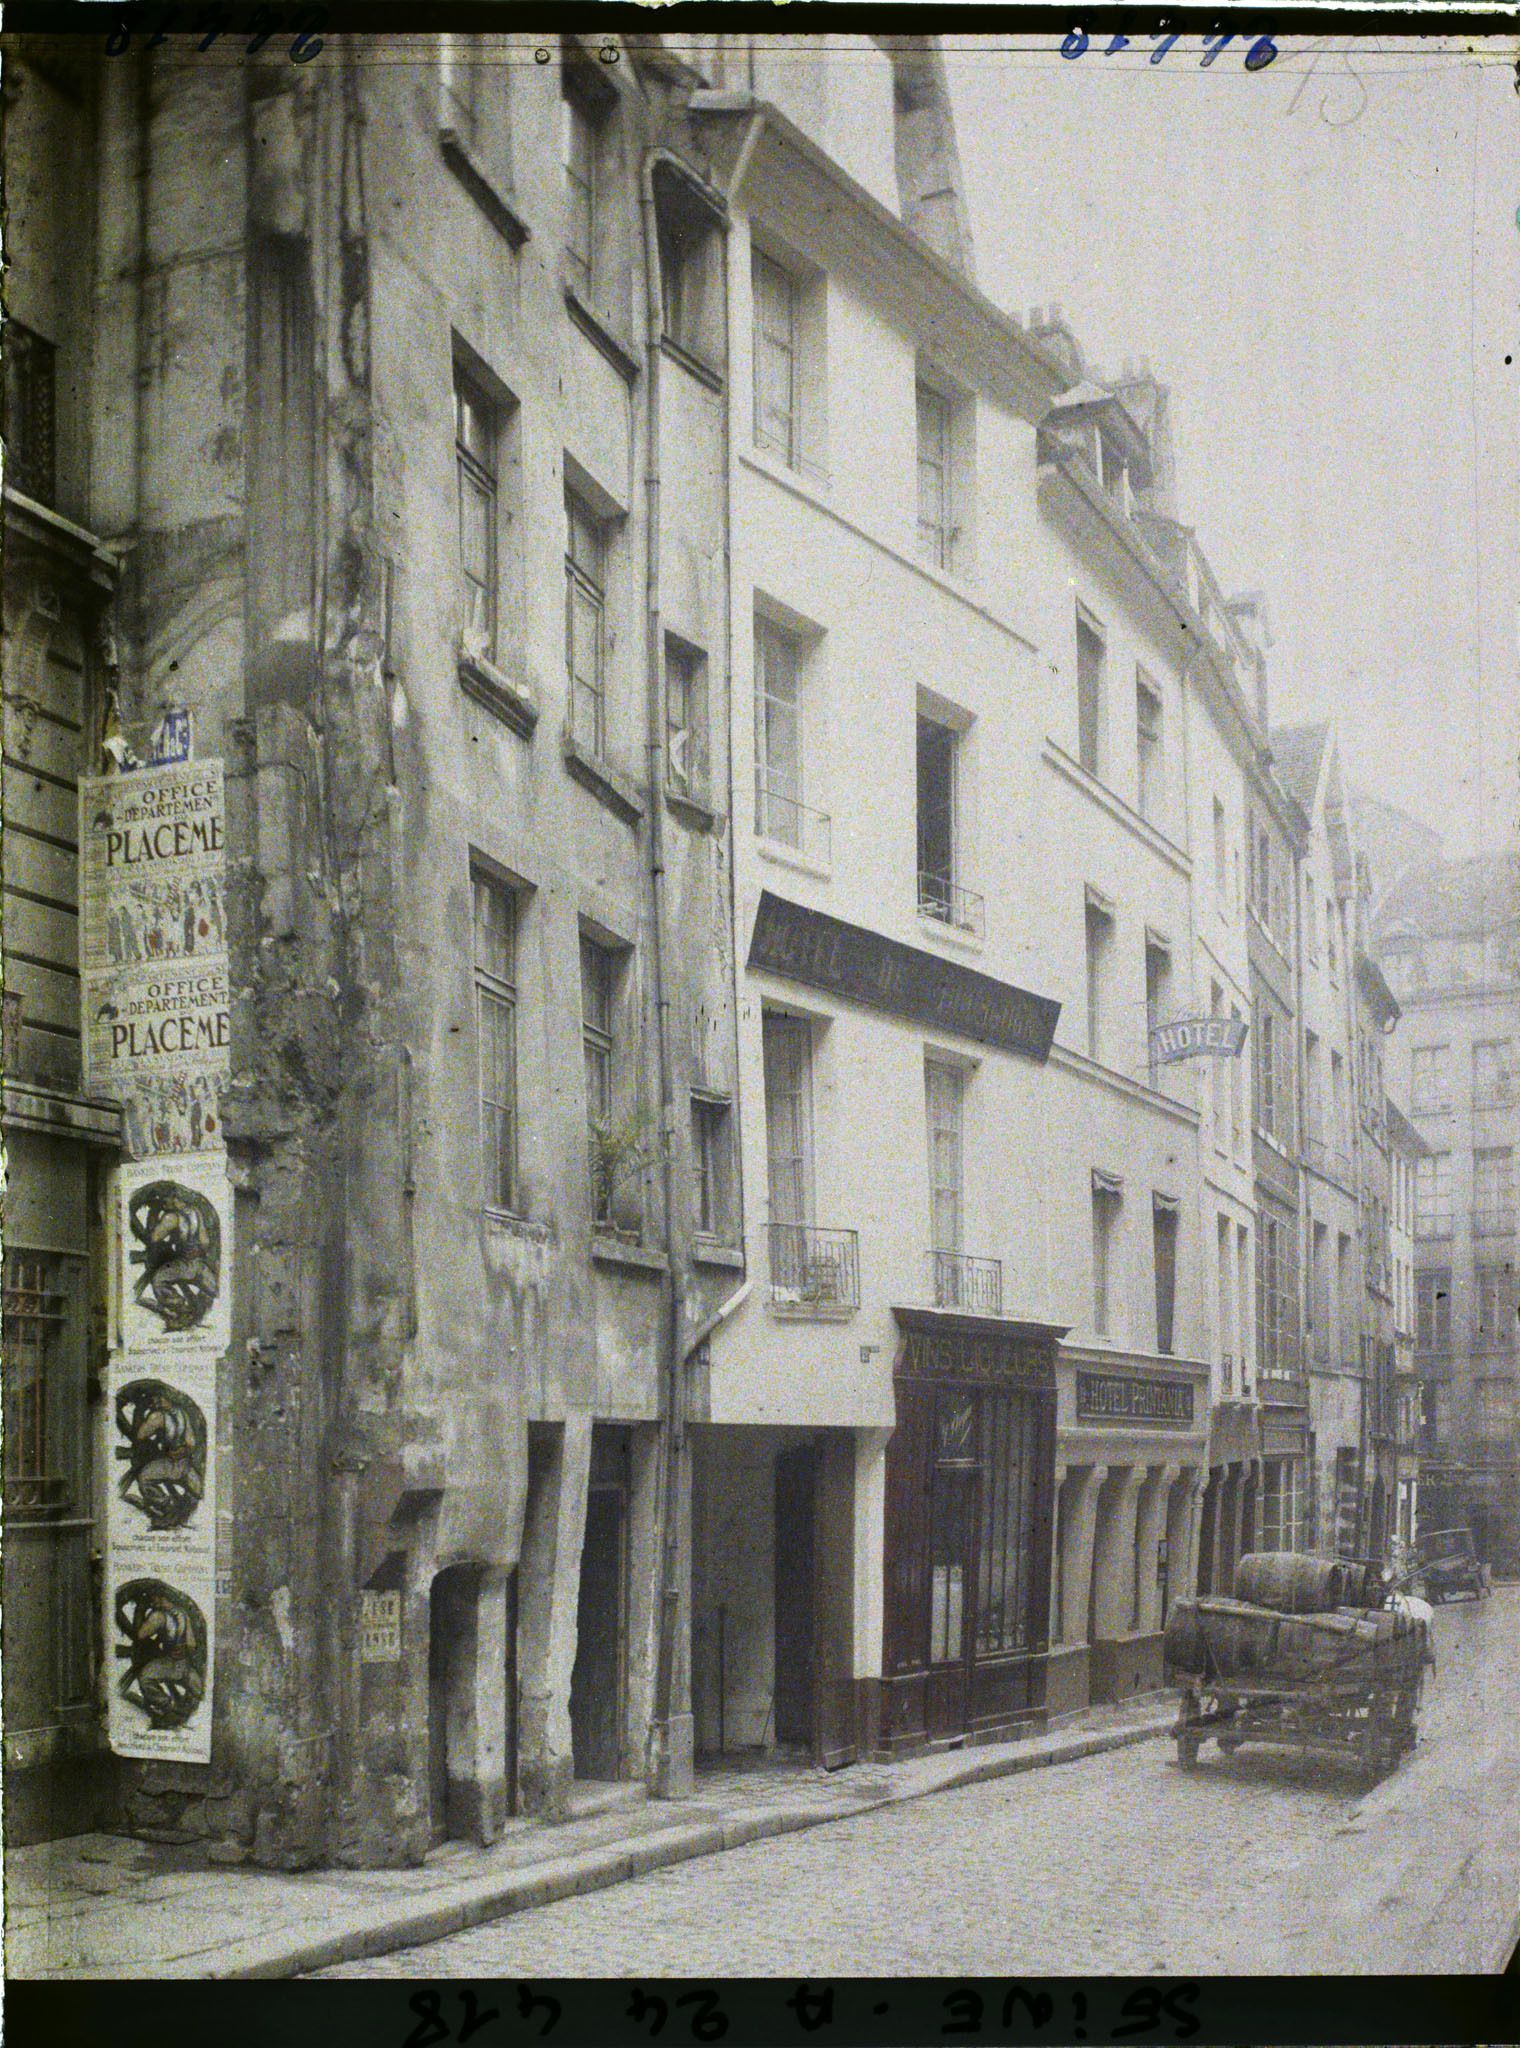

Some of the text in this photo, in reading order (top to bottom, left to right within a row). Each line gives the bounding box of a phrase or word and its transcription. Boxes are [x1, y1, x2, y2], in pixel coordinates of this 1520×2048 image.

[142, 780, 218, 804] OFFICE
[106, 815, 225, 867] PLACEME
[147, 976, 223, 999] OFFICE
[111, 1011, 231, 1059] PLACEME
[1160, 1023, 1237, 1053] HOTEL
[1089, 1377, 1128, 1412] HOTEL
